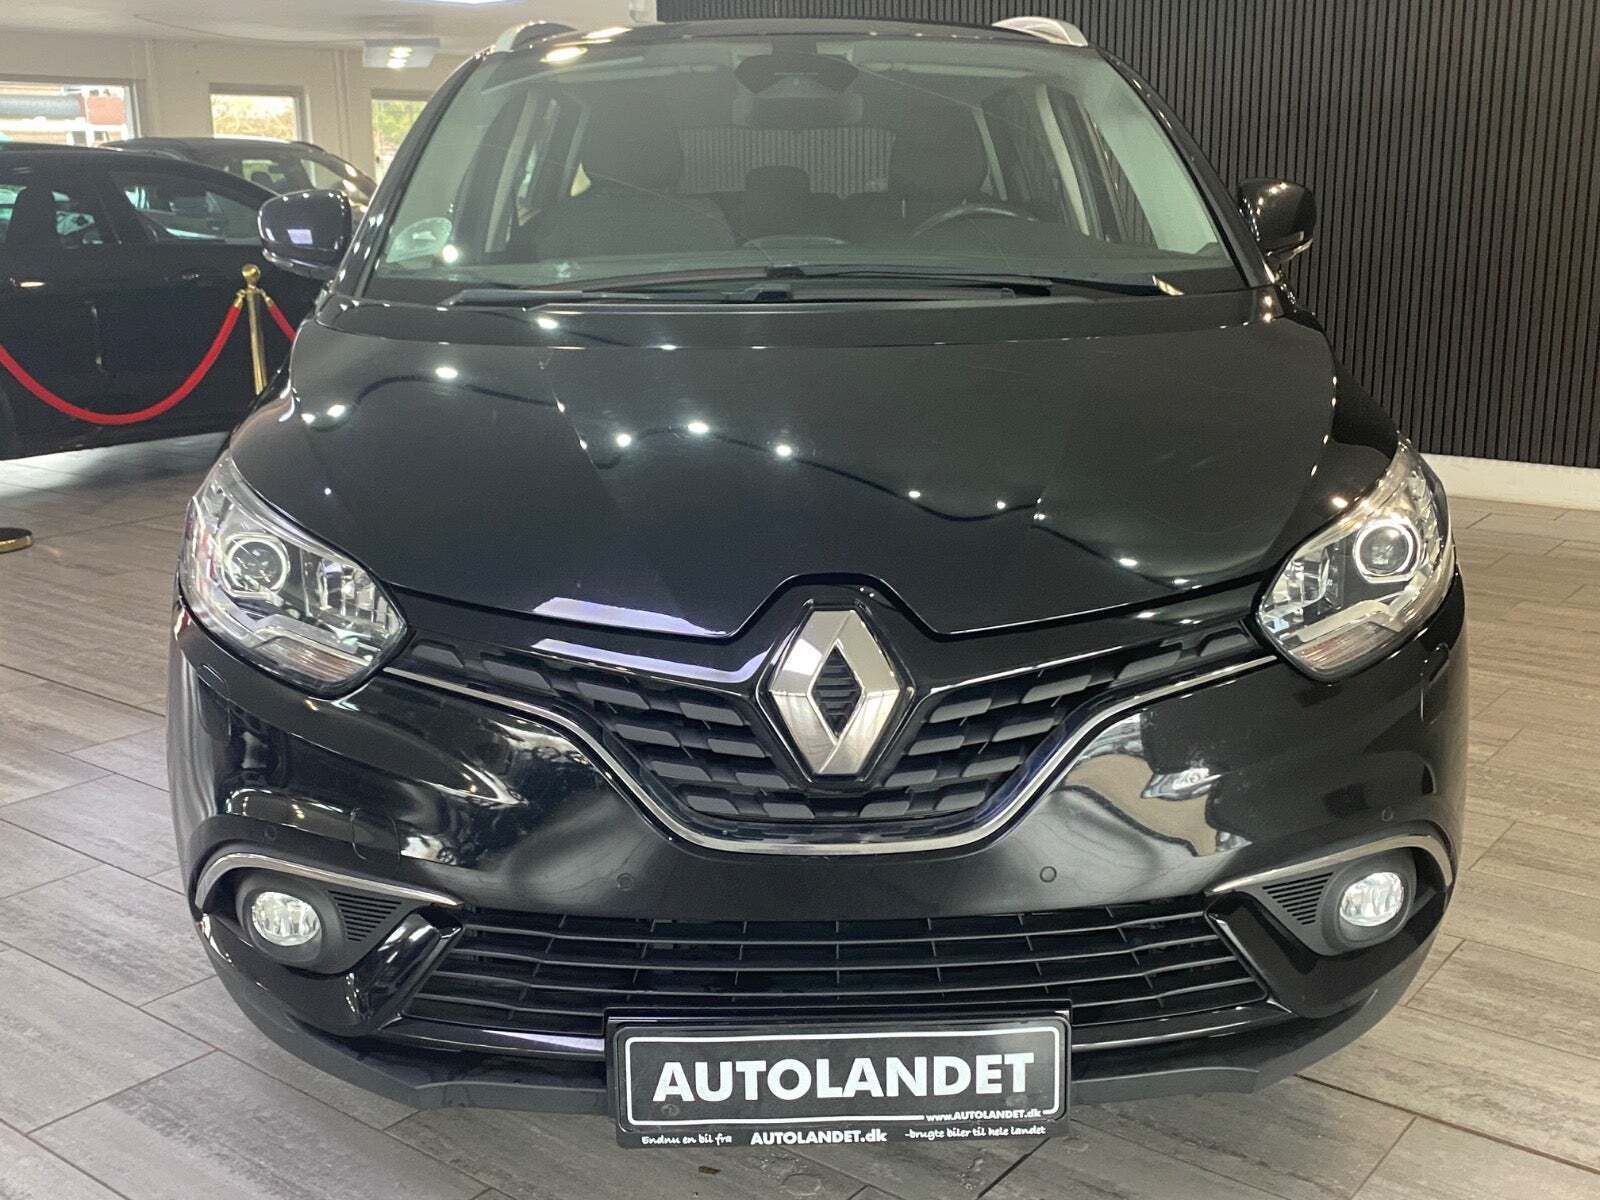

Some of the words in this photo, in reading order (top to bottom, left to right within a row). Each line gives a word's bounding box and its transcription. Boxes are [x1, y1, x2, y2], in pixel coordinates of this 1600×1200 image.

[652, 1052, 1035, 1103] AUTOLANDET
[926, 1108, 1042, 1121] www.AUTOLANDET.dk
[641, 1134, 681, 1145] Endnu
[682, 1135, 697, 1144] en
[698, 1133, 713, 1144] bil
[715, 1132, 732, 1146] fra
[750, 1128, 888, 1145] AUTOLANDET.dk
[946, 1126, 972, 1138] biler
[973, 1126, 986, 1137] til
[988, 1125, 1009, 1137] hele
[1010, 1124, 1046, 1136] landet
